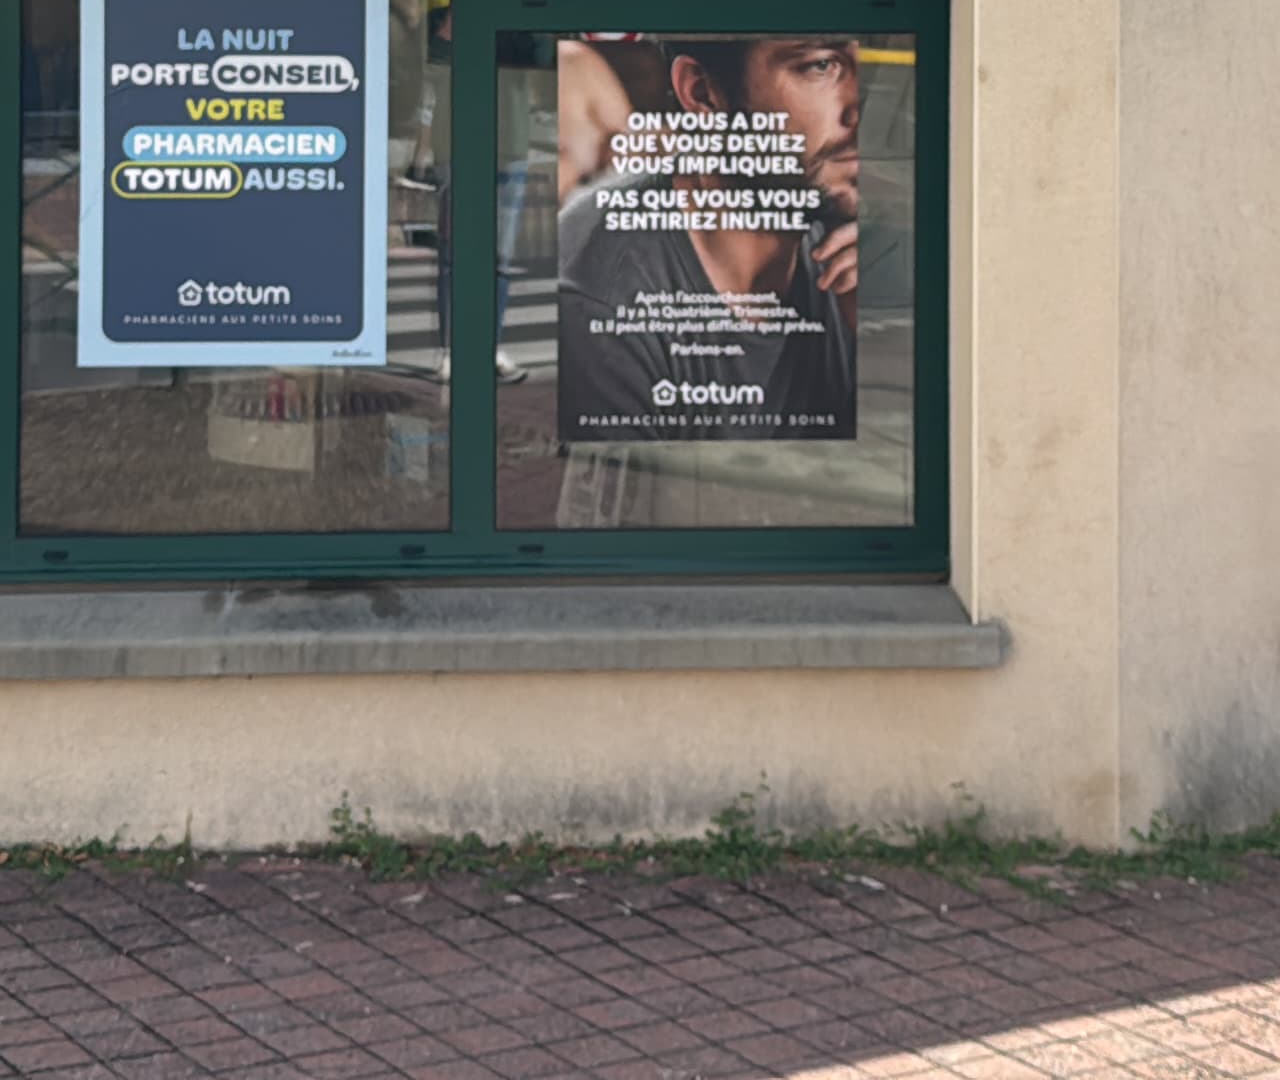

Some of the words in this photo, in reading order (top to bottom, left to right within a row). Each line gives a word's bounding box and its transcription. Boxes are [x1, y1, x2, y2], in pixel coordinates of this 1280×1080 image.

[177, 28, 214, 51] LA
[222, 28, 294, 51] NUIT
[111, 63, 209, 86] PORTE
[217, 63, 360, 92] CONSEIL,
[185, 98, 285, 121] VOTRE
[627, 112, 662, 131] ON
[665, 112, 728, 131] VOUS
[731, 112, 748, 131] A
[752, 112, 790, 131] DIT
[133, 133, 336, 156] PHARMACIEN
[610, 134, 657, 154] QUE
[660, 134, 722, 153] VOUS
[727, 134, 806, 153] DEVIEZ
[612, 156, 674, 175] VOUS
[678, 156, 804, 176] IMPLIQUER.
[124, 168, 232, 191] TOTUM
[244, 168, 345, 191] AUSSI.
[596, 189, 639, 209] PAS
[642, 189, 689, 211] QUE
[692, 189, 754, 209] VOUS
[757, 189, 821, 209] VOUS
[605, 211, 718, 231] SENTIRIEZ
[721, 211, 810, 231] INUTILE.
[206, 281, 290, 305] totum
[124, 315, 216, 325] PHARMACIENS
[221, 315, 247, 325] AUX
[253, 315, 297, 325] PETITS
[303, 315, 342, 325] SOINS
[680, 381, 764, 405] totum
[579, 415, 688, 427] PHARMACIENS
[693, 415, 724, 427] AUX
[730, 415, 782, 427] PETITS
[789, 415, 836, 427] SOINS
